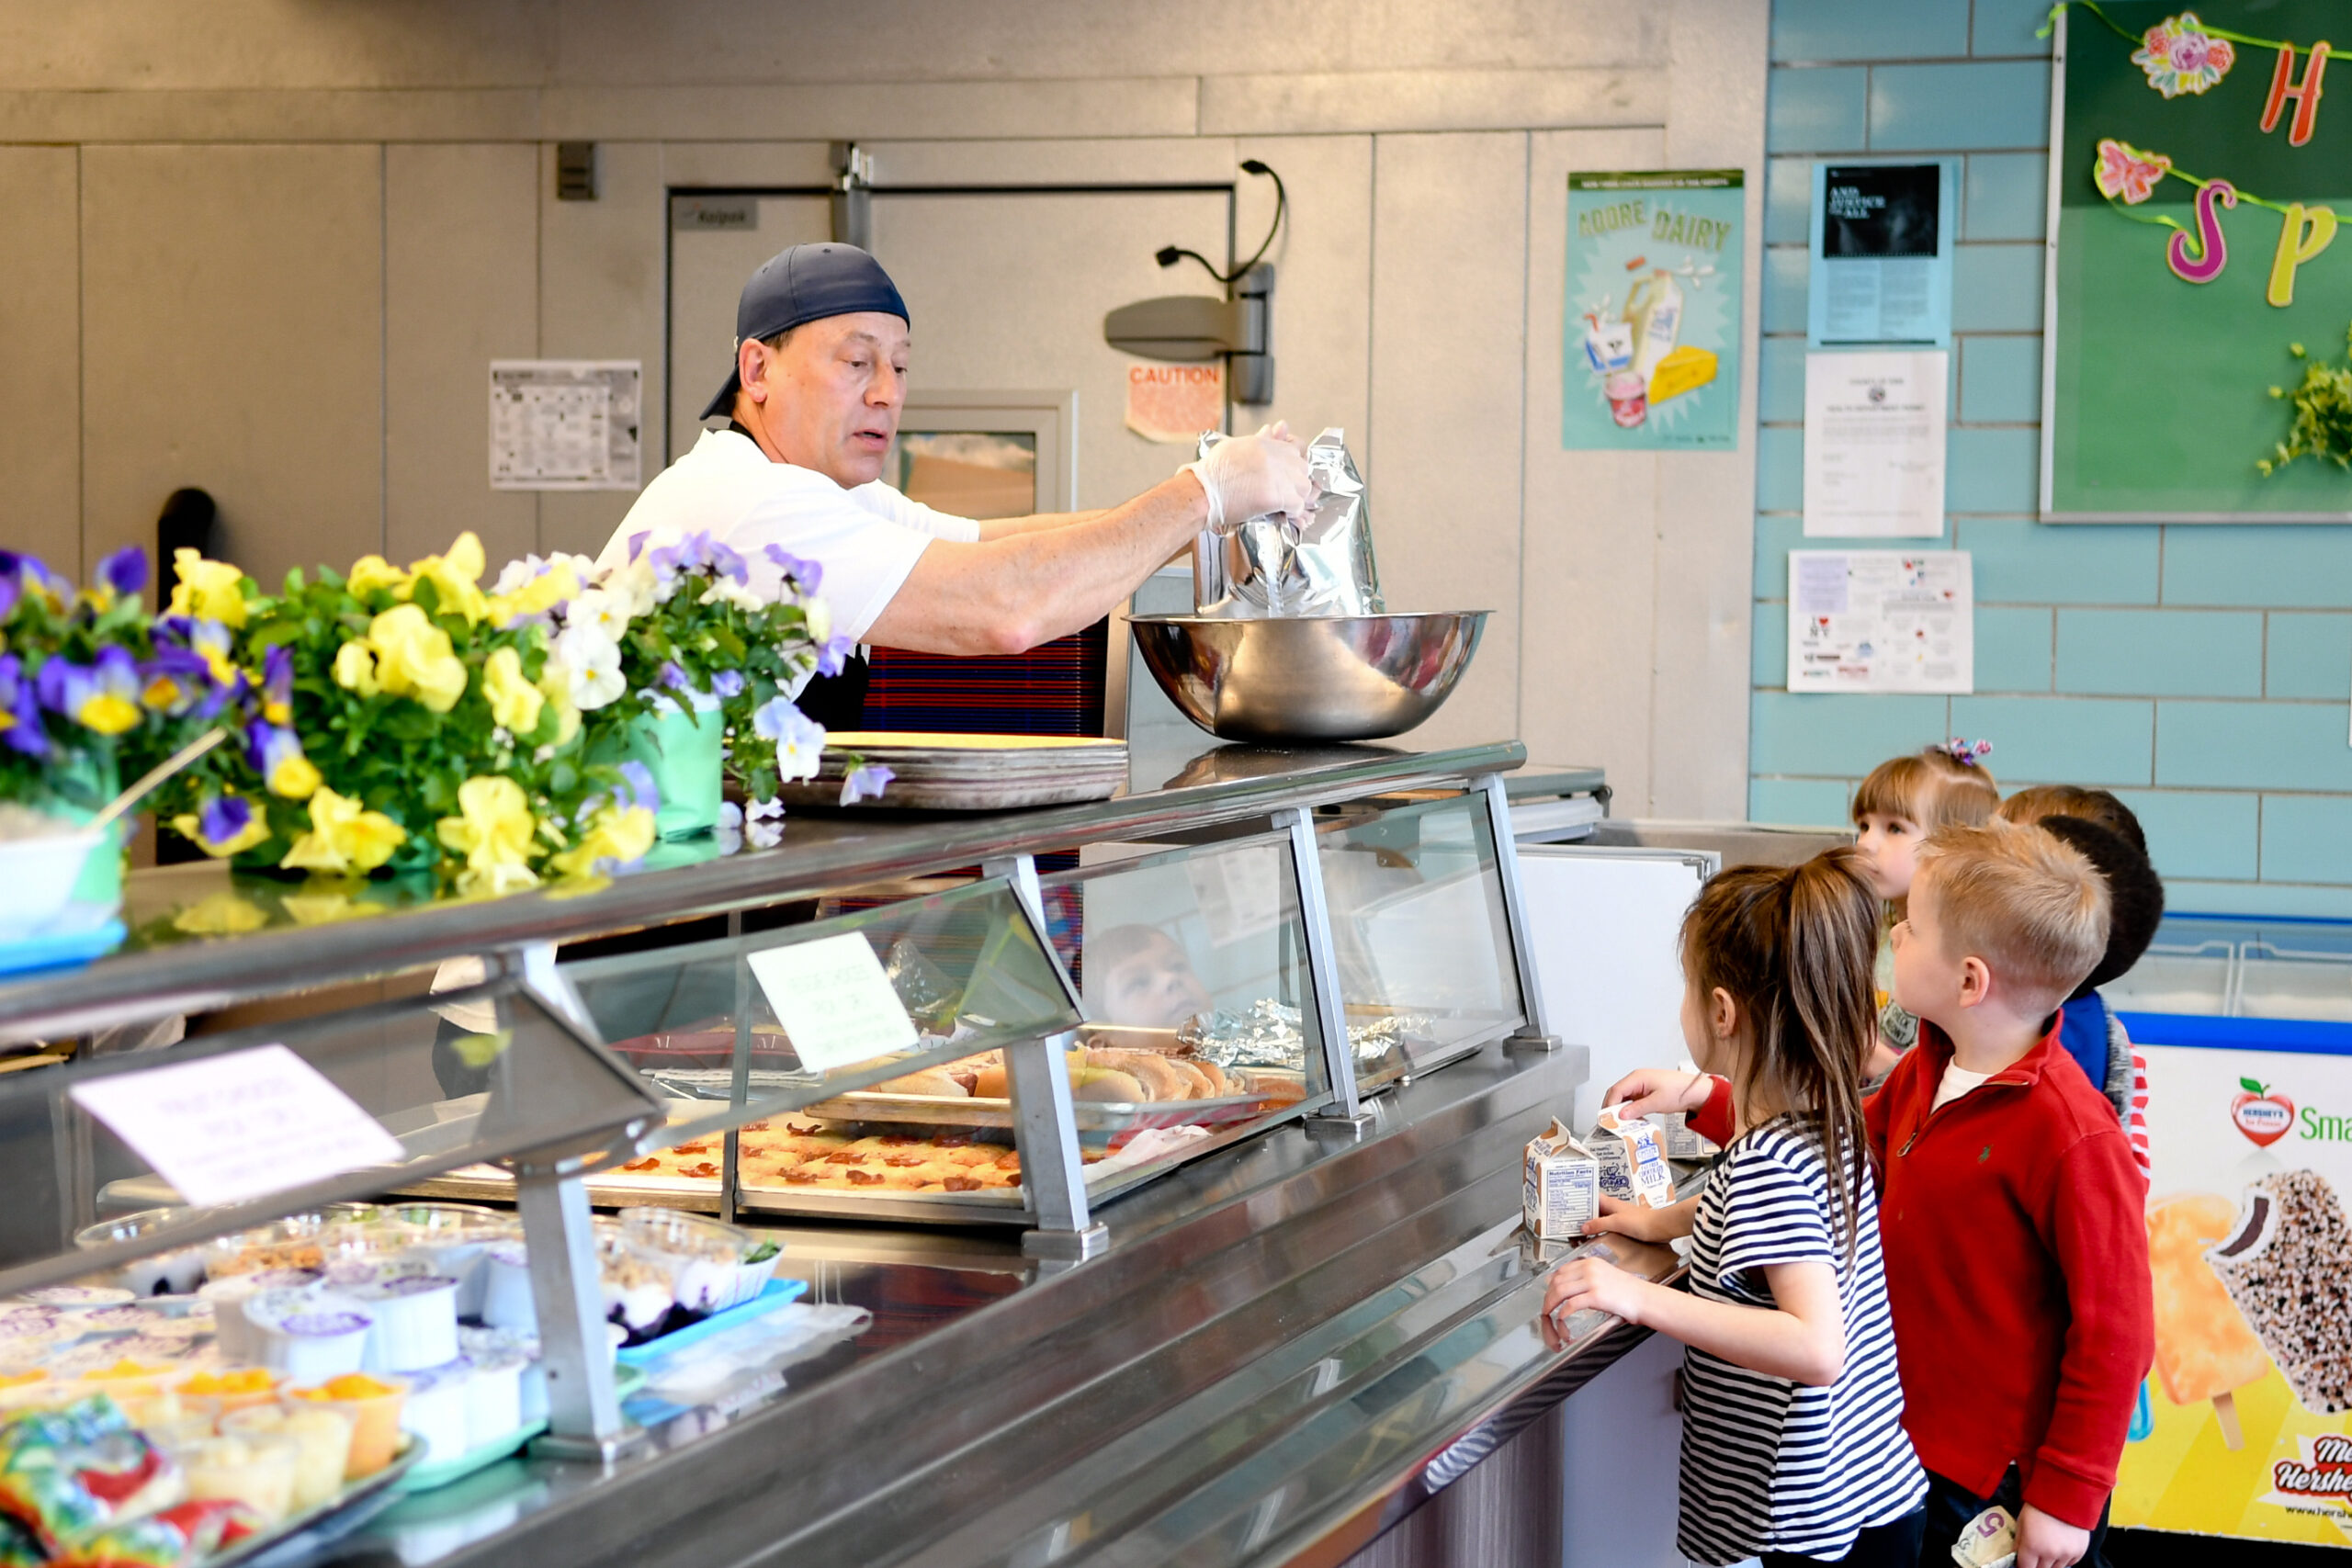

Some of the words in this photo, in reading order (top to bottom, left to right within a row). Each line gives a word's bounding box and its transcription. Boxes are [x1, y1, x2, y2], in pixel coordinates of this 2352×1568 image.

[2259, 40, 2332, 147] H
[1578, 198, 1646, 238] ADORE
[1652, 209, 1732, 252] DAIRY
[1130, 367, 1220, 385] CAUTION
[2244, 1108, 2284, 1119] HERSHEY'S
[1641, 1172, 1666, 1188] MILK
[1977, 1512, 2005, 1539] 5
